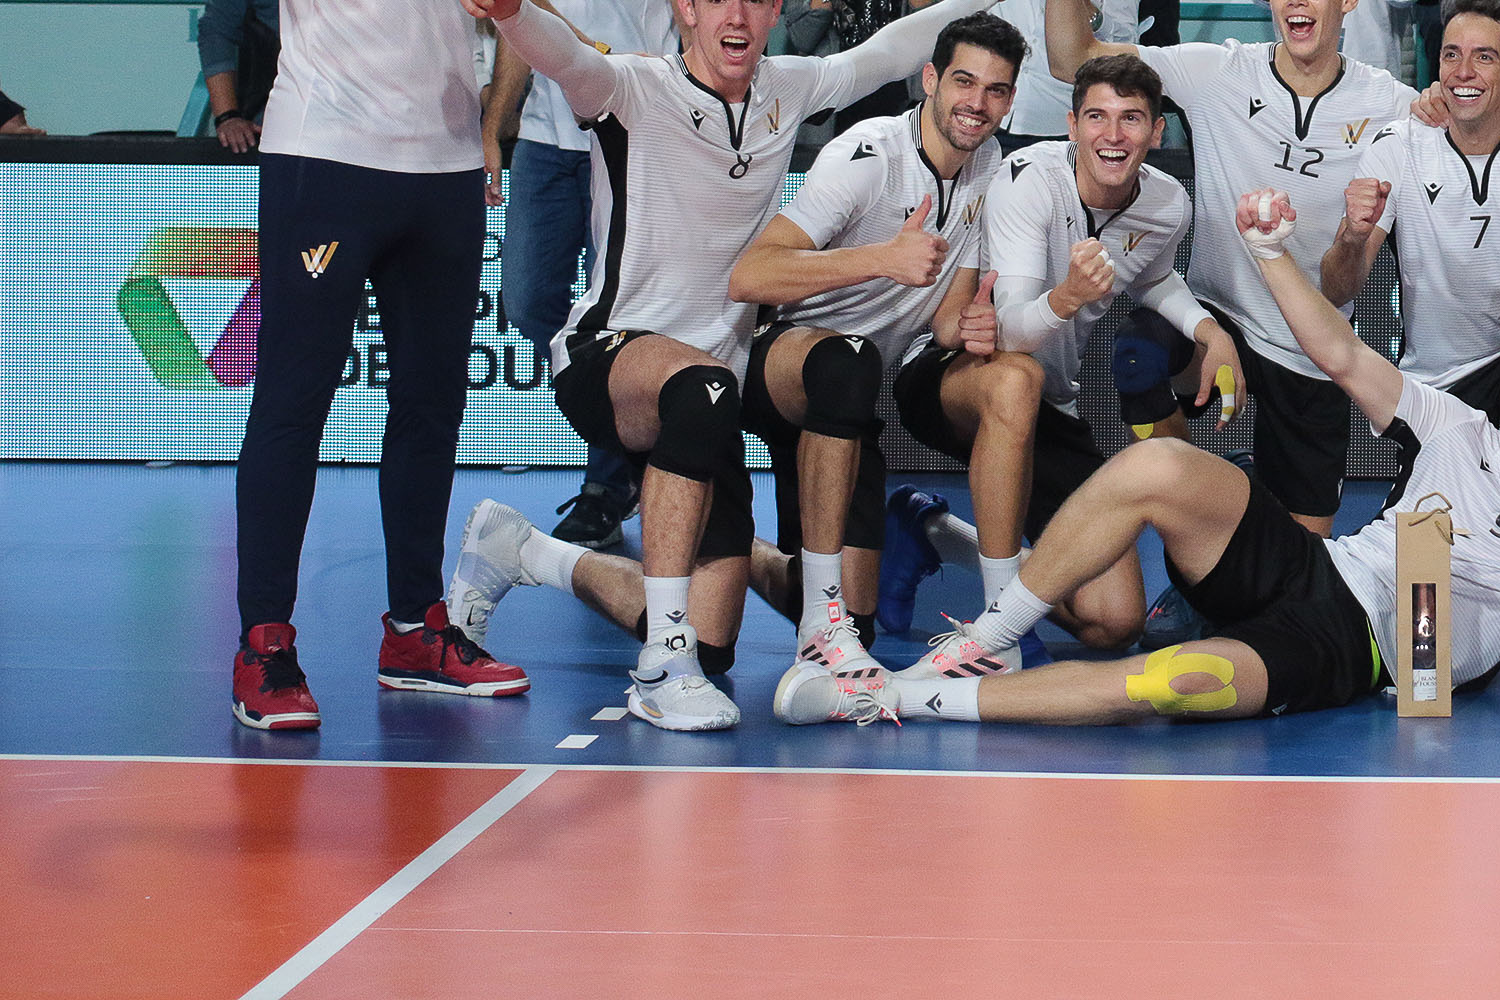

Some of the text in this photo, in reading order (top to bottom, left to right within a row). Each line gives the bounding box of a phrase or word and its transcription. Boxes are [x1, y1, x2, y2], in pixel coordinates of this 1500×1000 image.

[729, 153, 752, 179] 8
[1274, 140, 1325, 178] 12
[1469, 215, 1491, 249] 7
